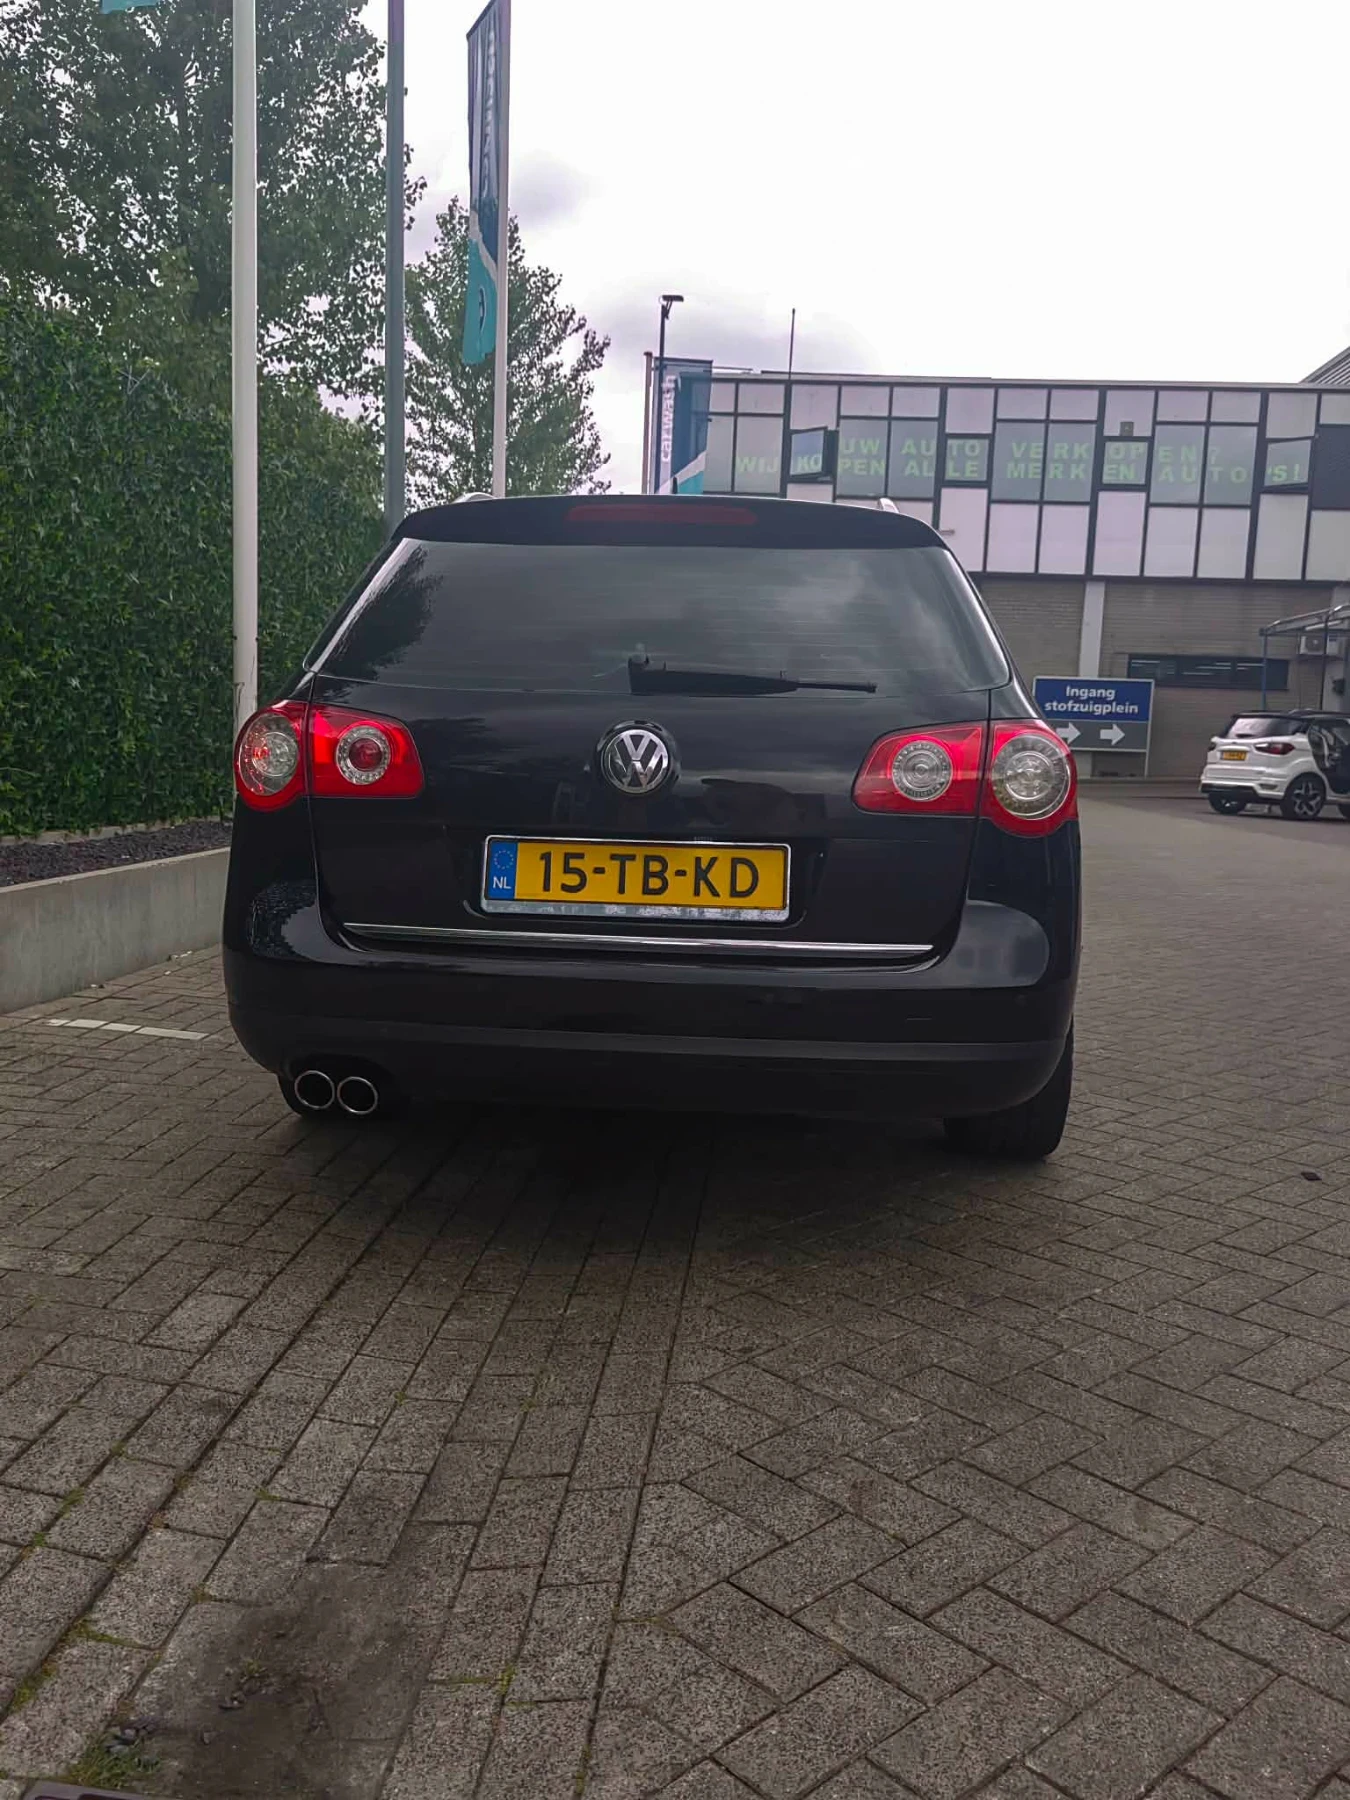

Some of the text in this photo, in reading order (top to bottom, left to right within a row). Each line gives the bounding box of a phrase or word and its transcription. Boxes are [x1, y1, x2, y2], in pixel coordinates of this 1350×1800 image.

[839, 437, 881, 456] UW
[900, 440, 982, 458] AUTO
[736, 456, 779, 474] WIJ
[903, 459, 980, 478] ALLE
[1006, 462, 1135, 480] MERKEN
[1065, 685, 1116, 701] Ingang
[1044, 700, 1139, 716] stofzuigplein
[492, 875, 512, 890] NL
[539, 851, 760, 899] 15-TB-KD
